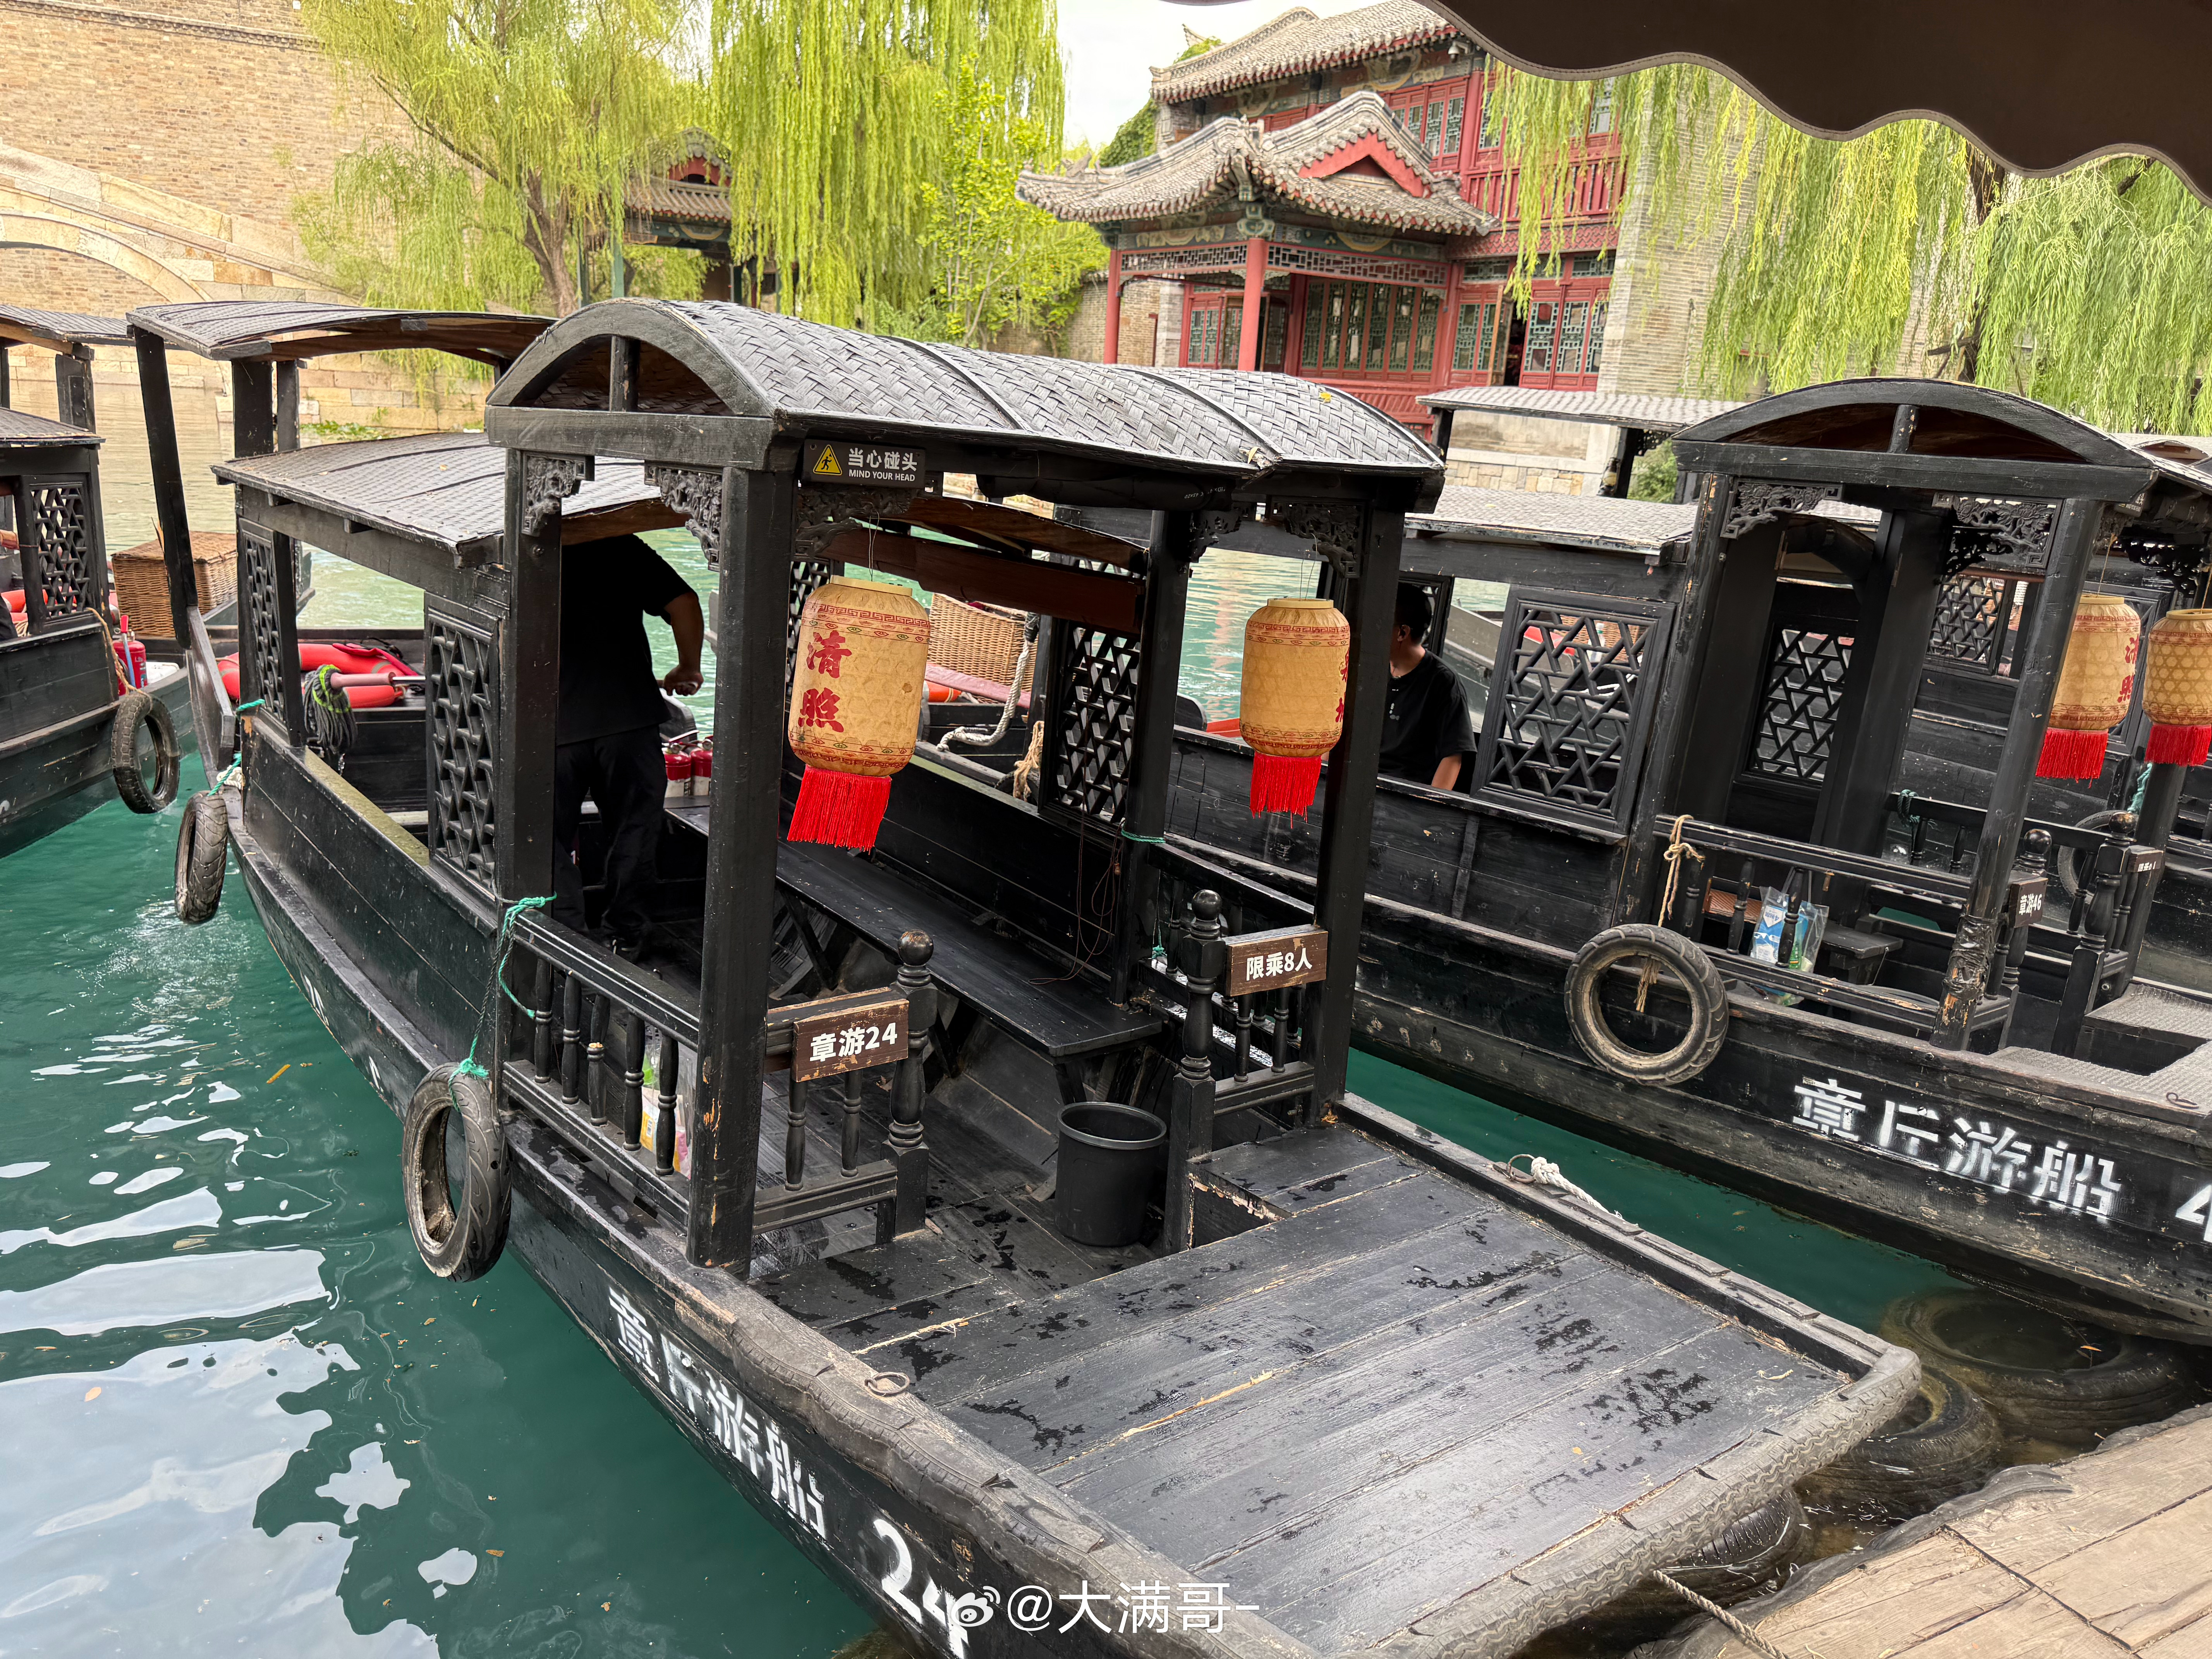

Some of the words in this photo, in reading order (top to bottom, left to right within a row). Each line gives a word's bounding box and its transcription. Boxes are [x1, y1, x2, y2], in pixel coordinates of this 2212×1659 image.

[848, 448, 917, 472] 当心碰头
[849, 469, 871, 478] MIND
[872, 471, 893, 480] YOUR
[895, 473, 915, 481] HEAD
[798, 630, 852, 732] 清照
[2019, 893, 2042, 915] 章游46
[1246, 947, 1313, 981] 限乘8人
[809, 1022, 898, 1062] 章游24
[1793, 1076, 2122, 1216] 章丘游船
